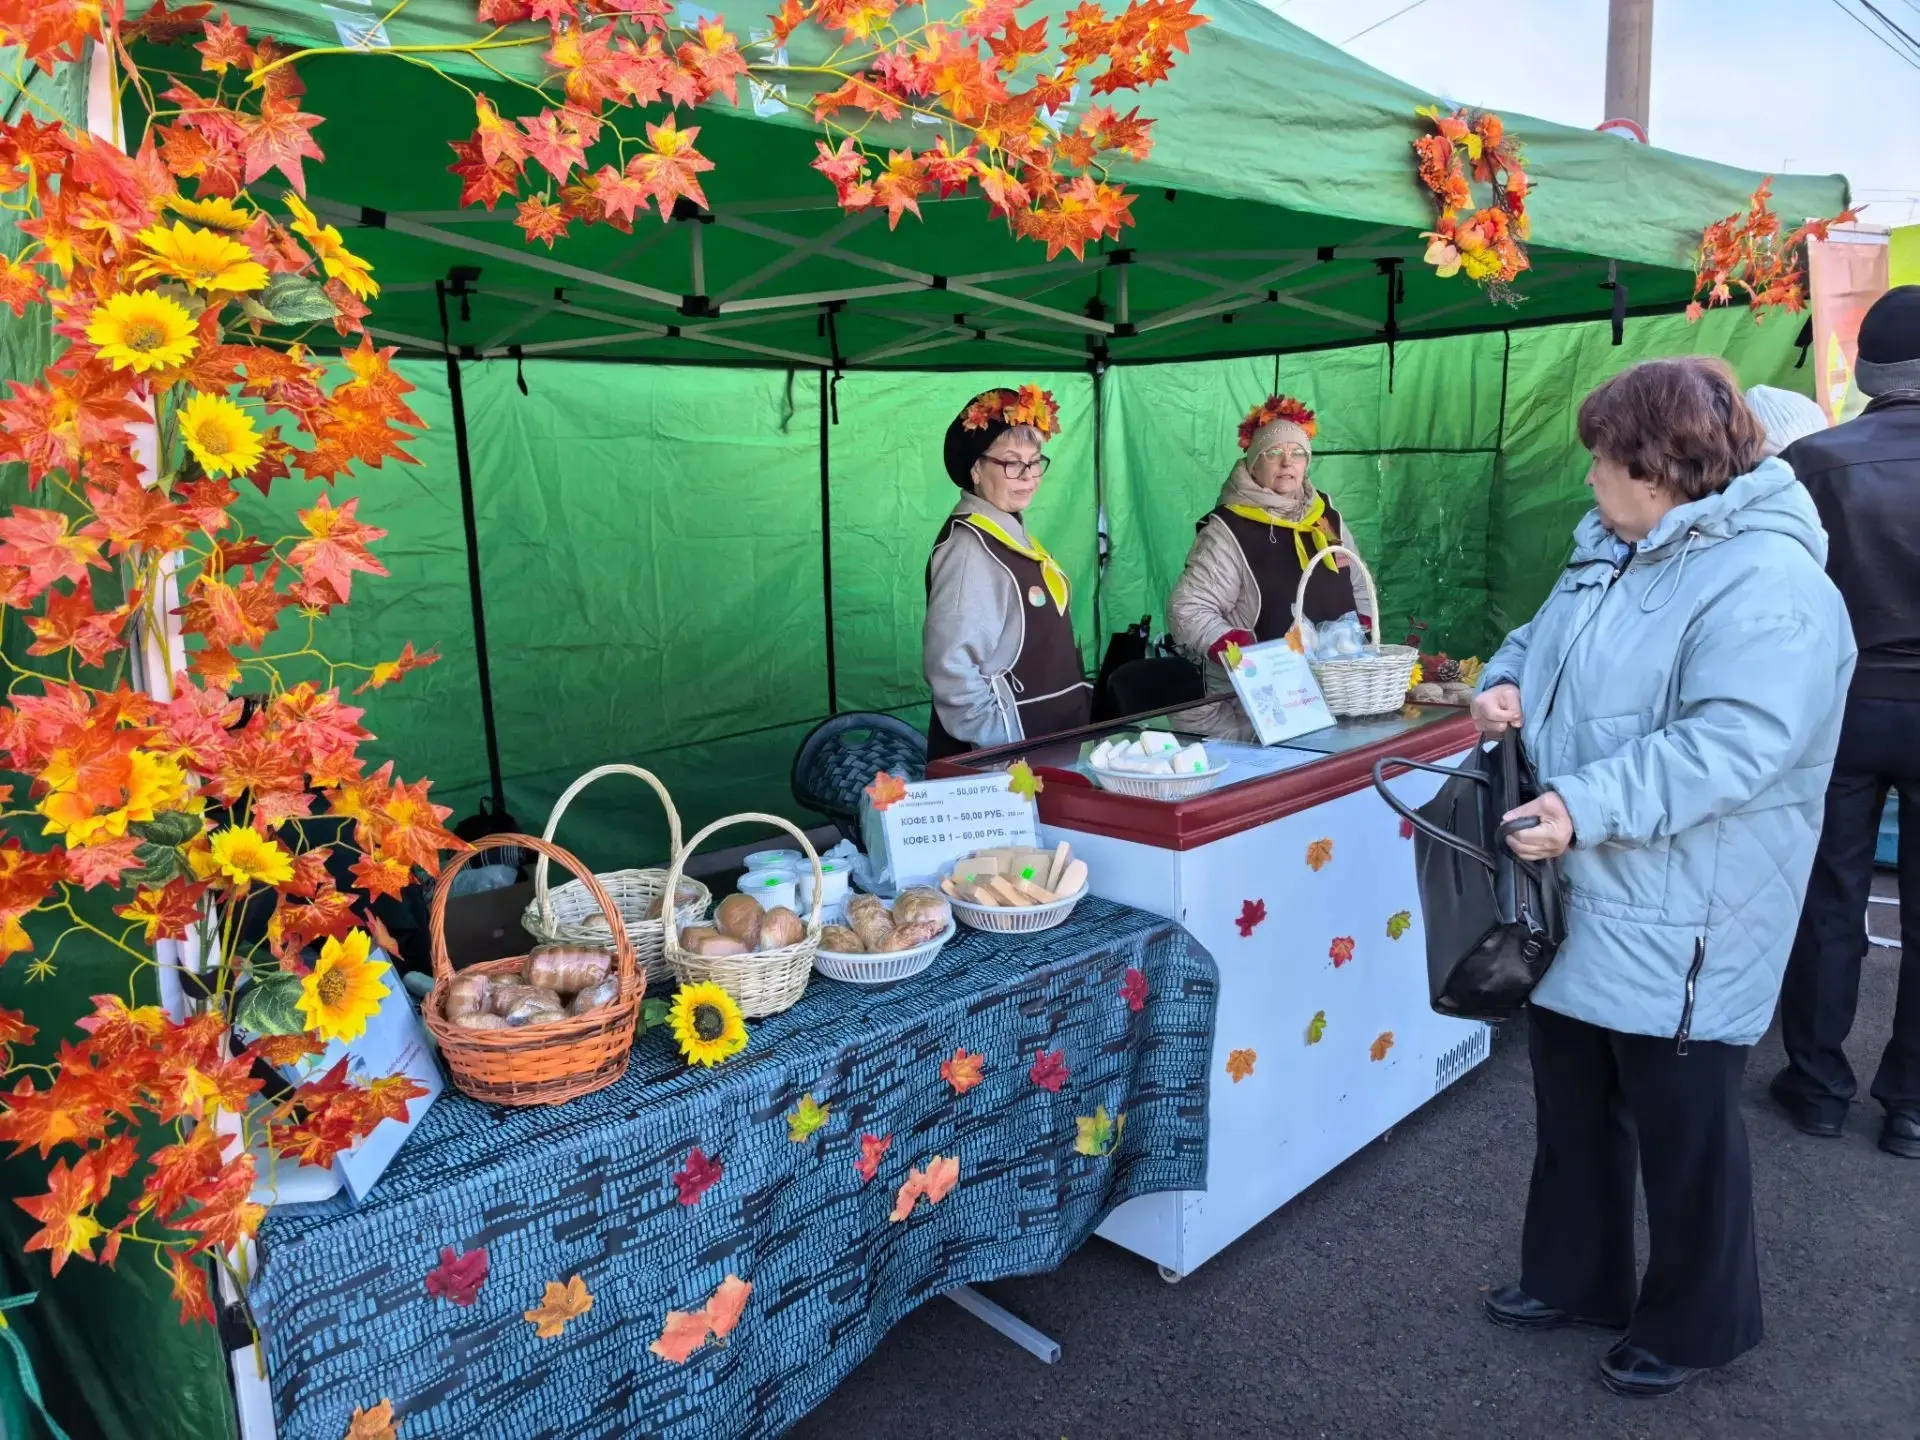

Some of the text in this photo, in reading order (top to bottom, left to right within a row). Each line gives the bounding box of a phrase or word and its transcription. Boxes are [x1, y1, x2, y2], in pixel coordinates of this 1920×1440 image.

[908, 789, 928, 799] ЧАЙ
[956, 787, 978, 796] 50,00
[900, 815, 927, 826] КОФЕ
[930, 815, 935, 823] 3
[946, 814, 951, 822] 1
[960, 811, 982, 821] 50,00
[984, 809, 1004, 819] РУБ.
[903, 835, 930, 846] КОФЕ
[932, 834, 937, 843] 3
[948, 833, 953, 841] 1
[962, 830, 985, 840] 60,00
[986, 828, 1006, 837] РУБ.
